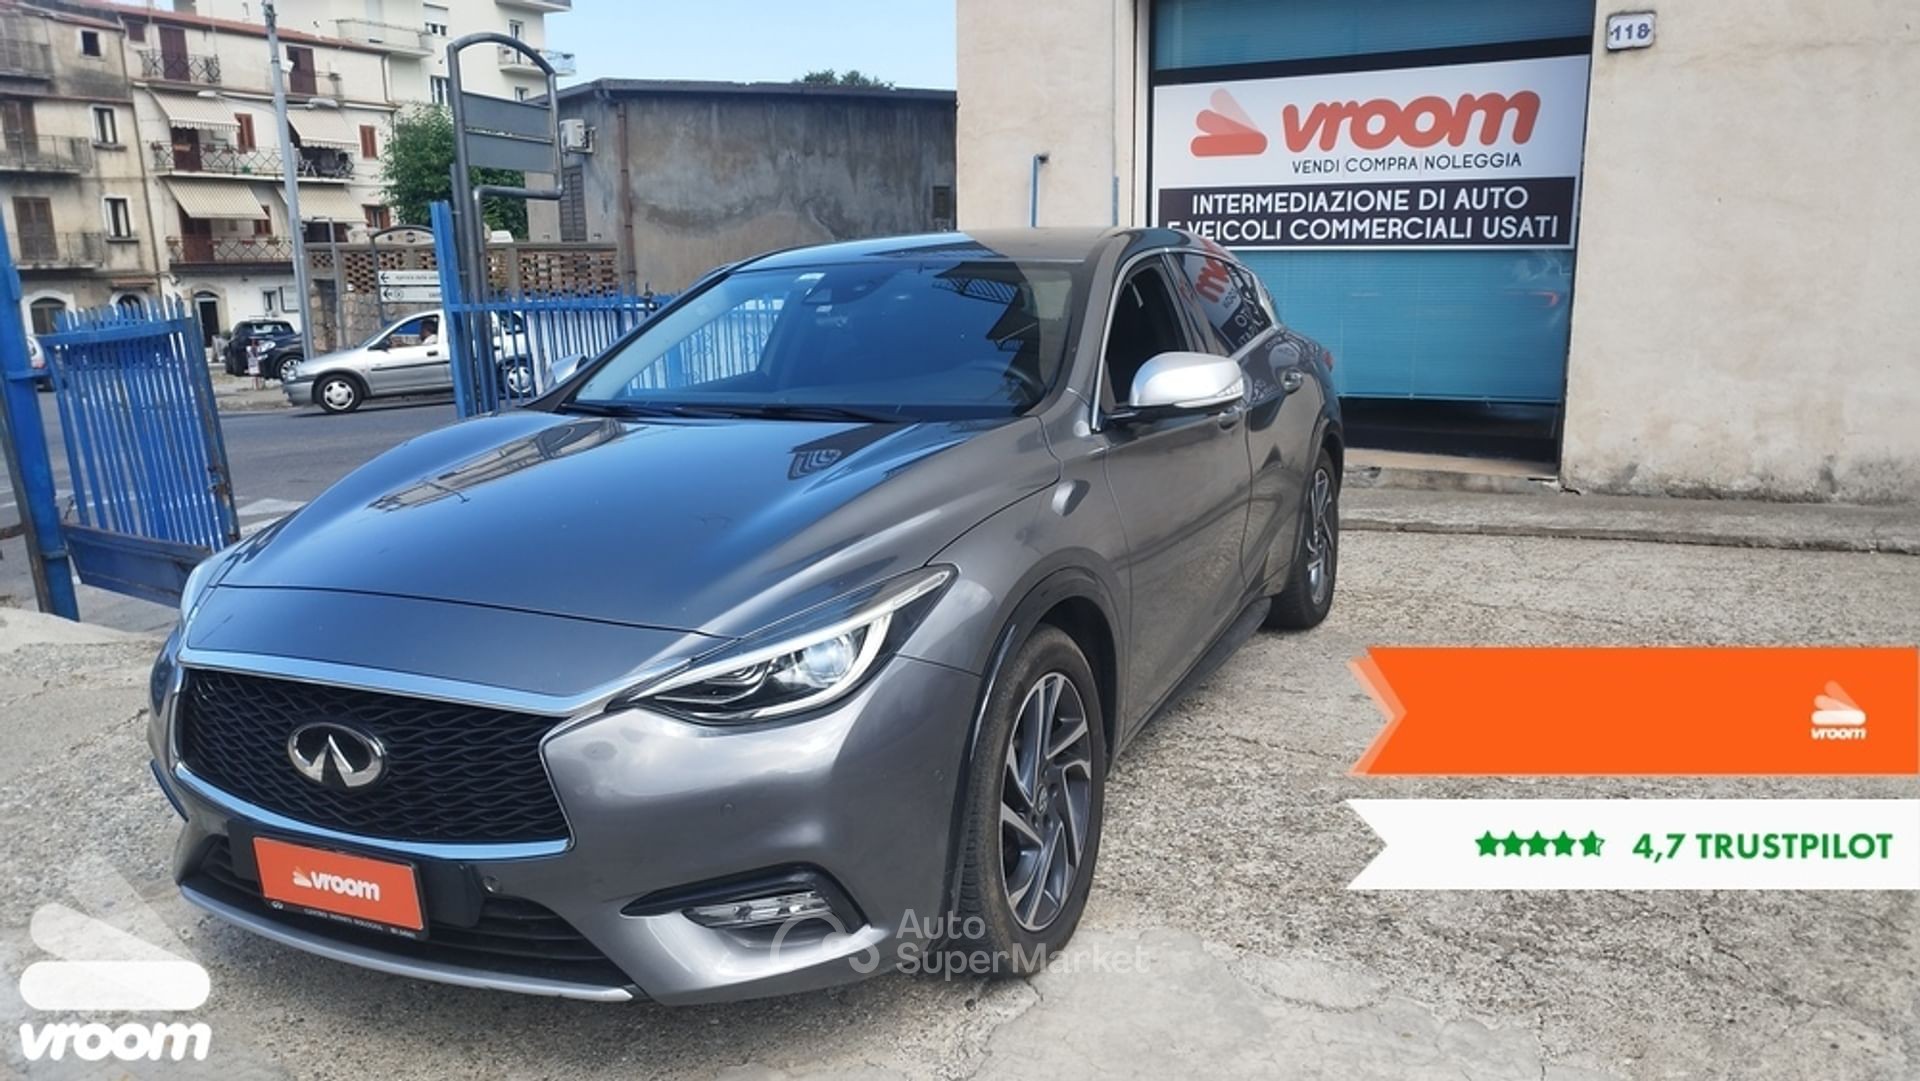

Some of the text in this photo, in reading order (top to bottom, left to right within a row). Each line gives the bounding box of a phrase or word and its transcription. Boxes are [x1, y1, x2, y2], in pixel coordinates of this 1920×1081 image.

[1612, 22, 1650, 41] 118
[1282, 90, 1541, 153] vroom
[1292, 152, 1522, 174] VENDI COMPRA NOLEGGIA
[1191, 185, 1529, 215] INTERMEDIAZIONE DI AUTO
[1187, 219, 1282, 241] VEICOLI
[1289, 216, 1473, 240] COMMERCIALI
[1482, 214, 1559, 239] USATI
[310, 871, 380, 902] vroom
